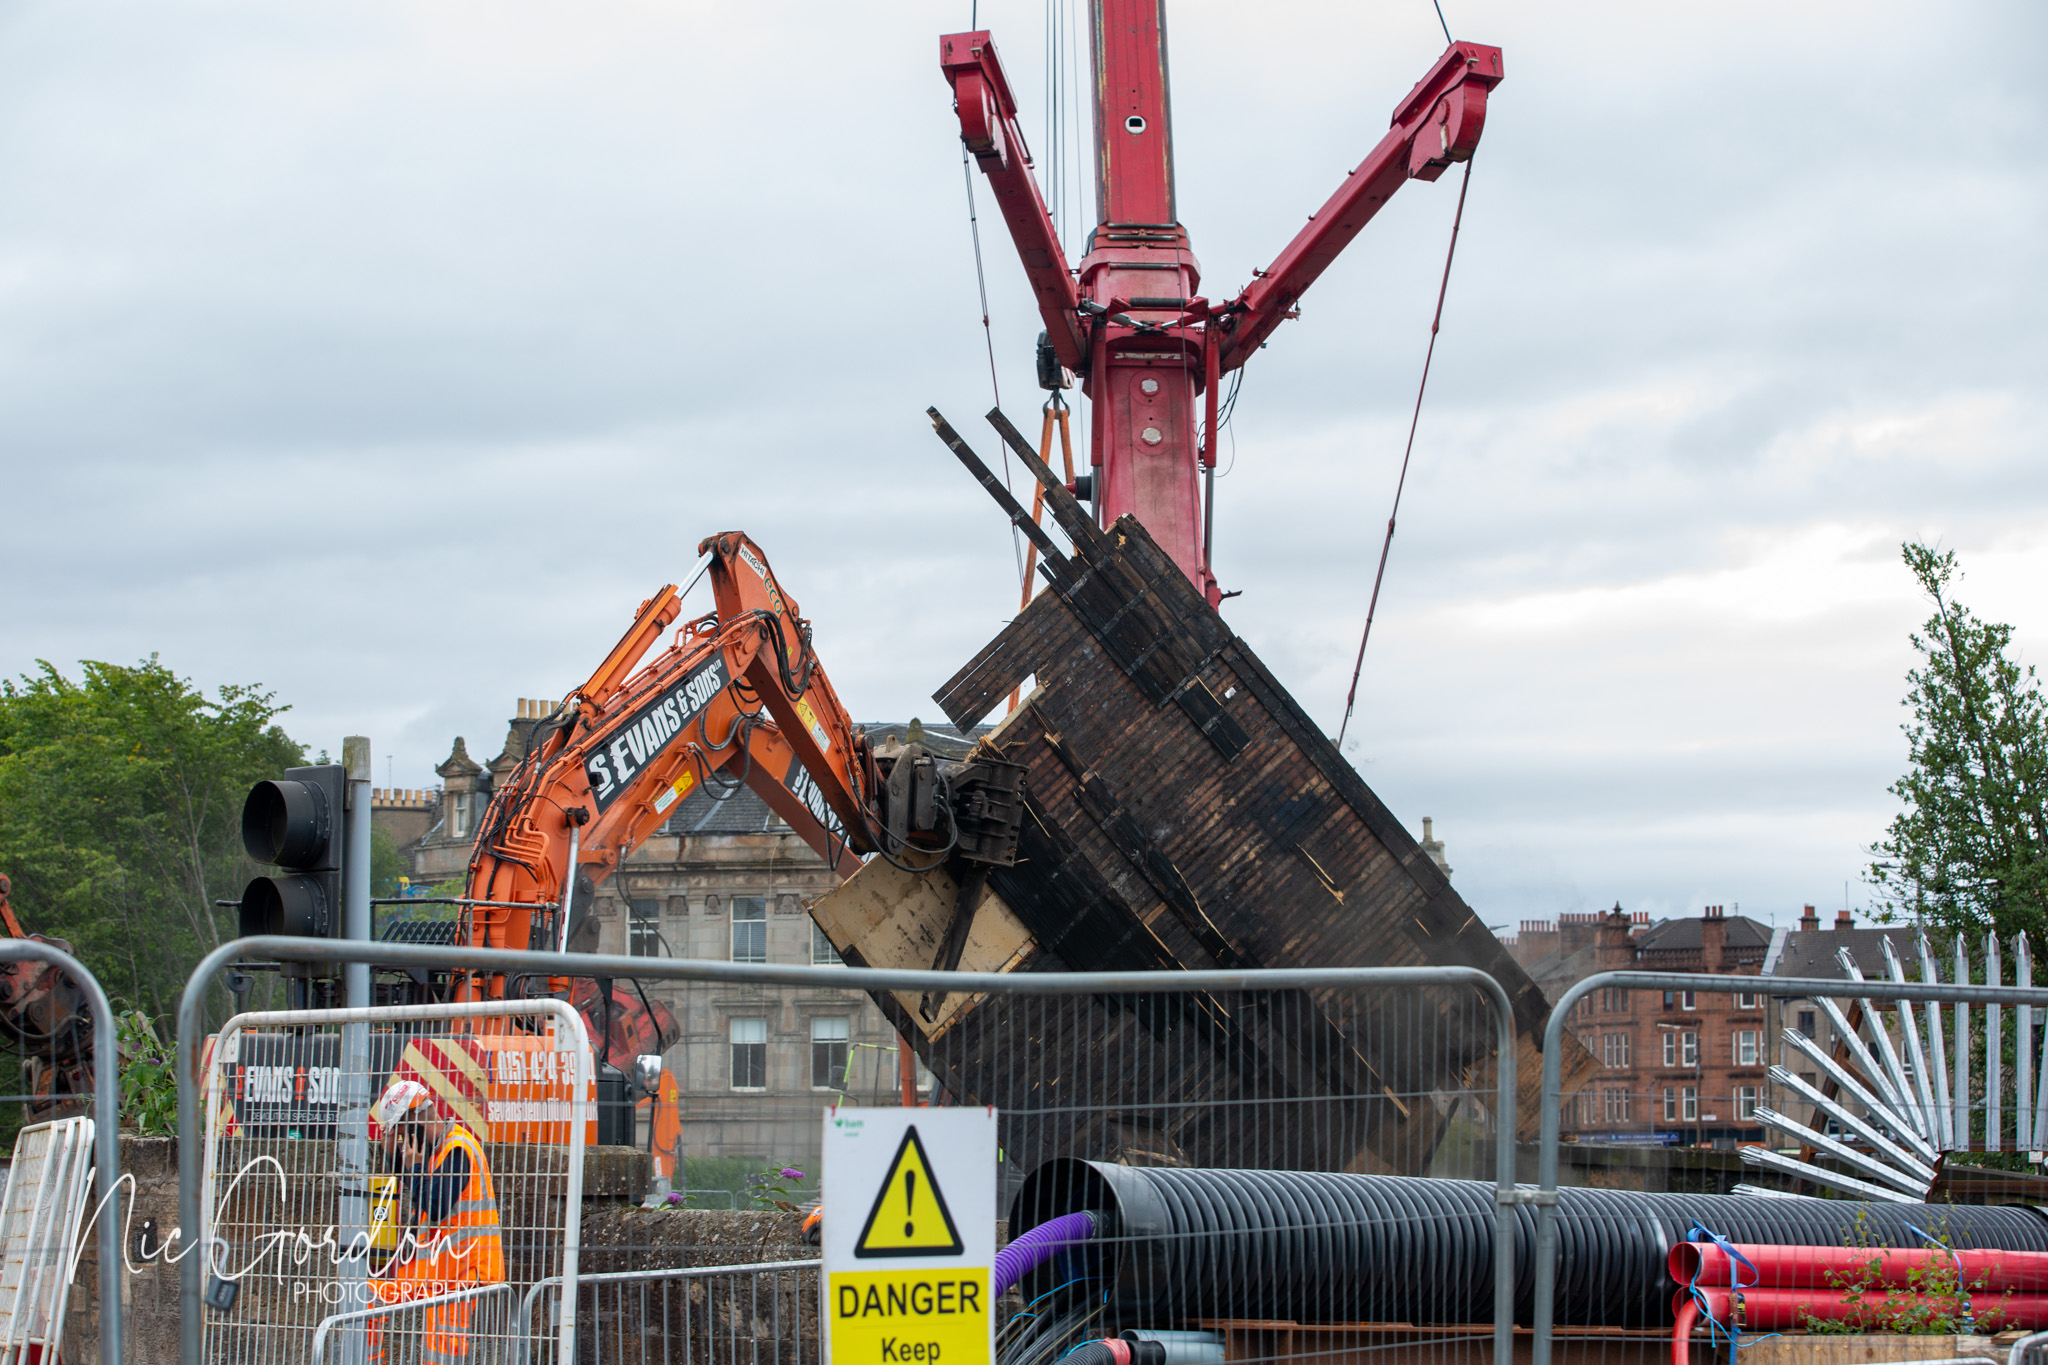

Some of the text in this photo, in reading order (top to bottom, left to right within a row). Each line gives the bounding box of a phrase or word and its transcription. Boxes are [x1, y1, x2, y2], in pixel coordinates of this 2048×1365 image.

[741, 547, 765, 576] HITACHI
[764, 577, 783, 615] eco
[589, 753, 615, 801] S
[610, 697, 682, 784] EVANS
[675, 688, 691, 720] &
[685, 664, 722, 712] SONS
[244, 1066, 294, 1103] EVANS
[497, 1050, 528, 1085] 0151
[531, 1051, 558, 1085] 424
[561, 1051, 596, 1086] 394
[839, 1280, 981, 1318] DANGER
[882, 1336, 941, 1365] Keep
